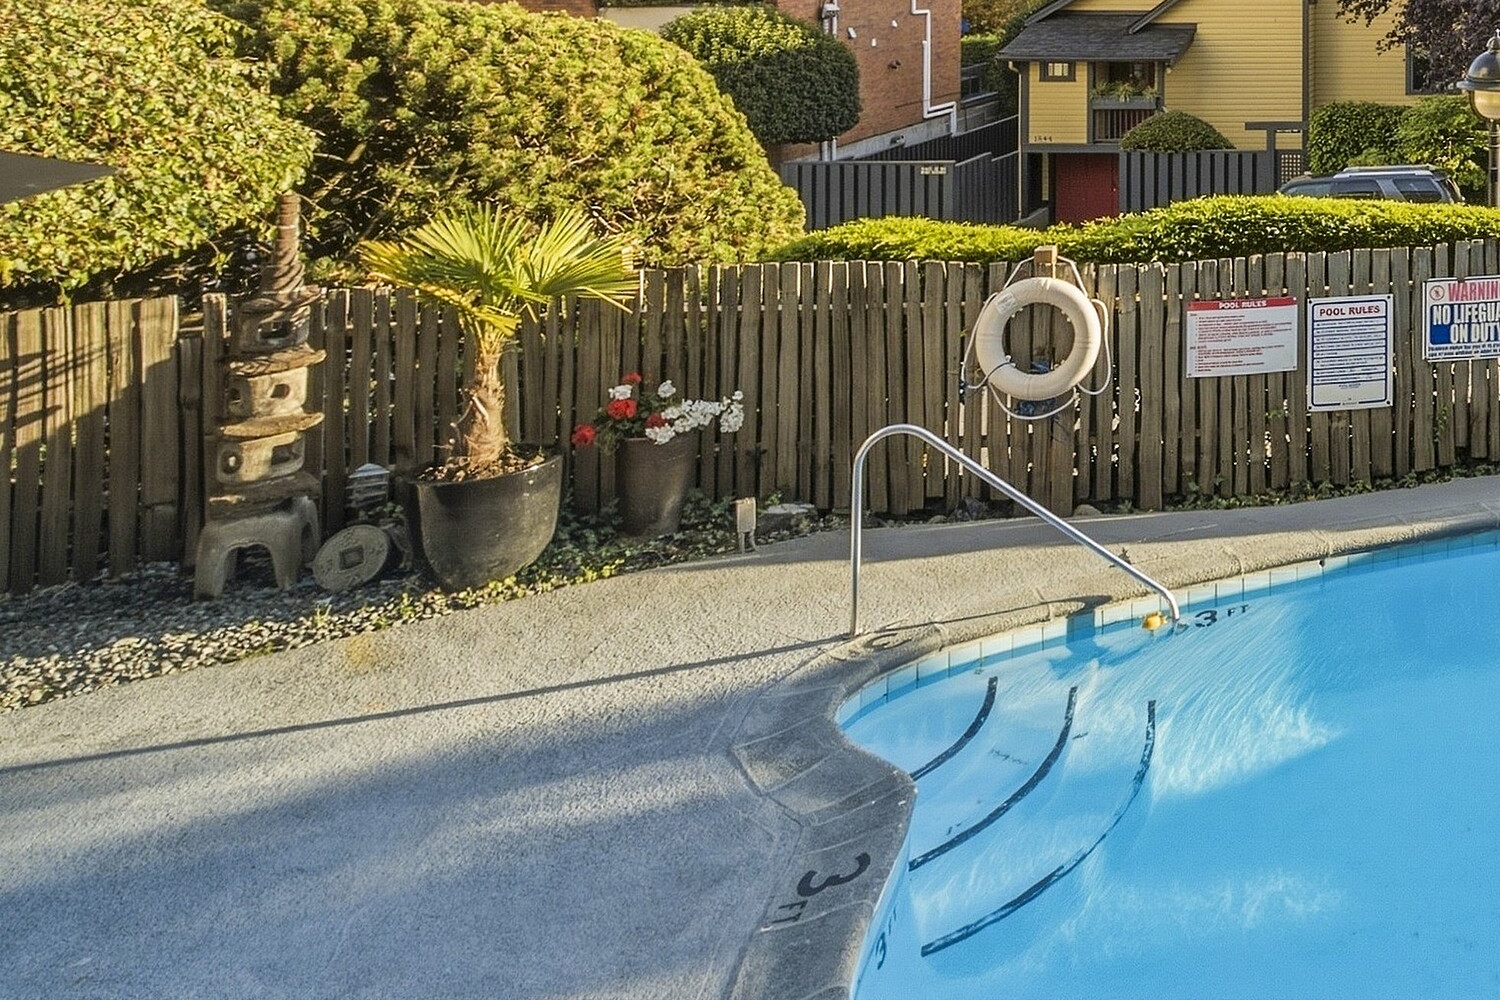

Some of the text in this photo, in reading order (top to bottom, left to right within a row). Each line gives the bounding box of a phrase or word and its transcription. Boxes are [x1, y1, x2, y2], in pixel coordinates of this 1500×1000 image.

[1219, 300, 1267, 309] POOL RULES
[1320, 305, 1380, 316] POOL RULES
[1432, 304, 1451, 325] NO
[1450, 323, 1469, 344] ON
[1194, 604, 1249, 628] 3 FT
[796, 852, 871, 897] 3
